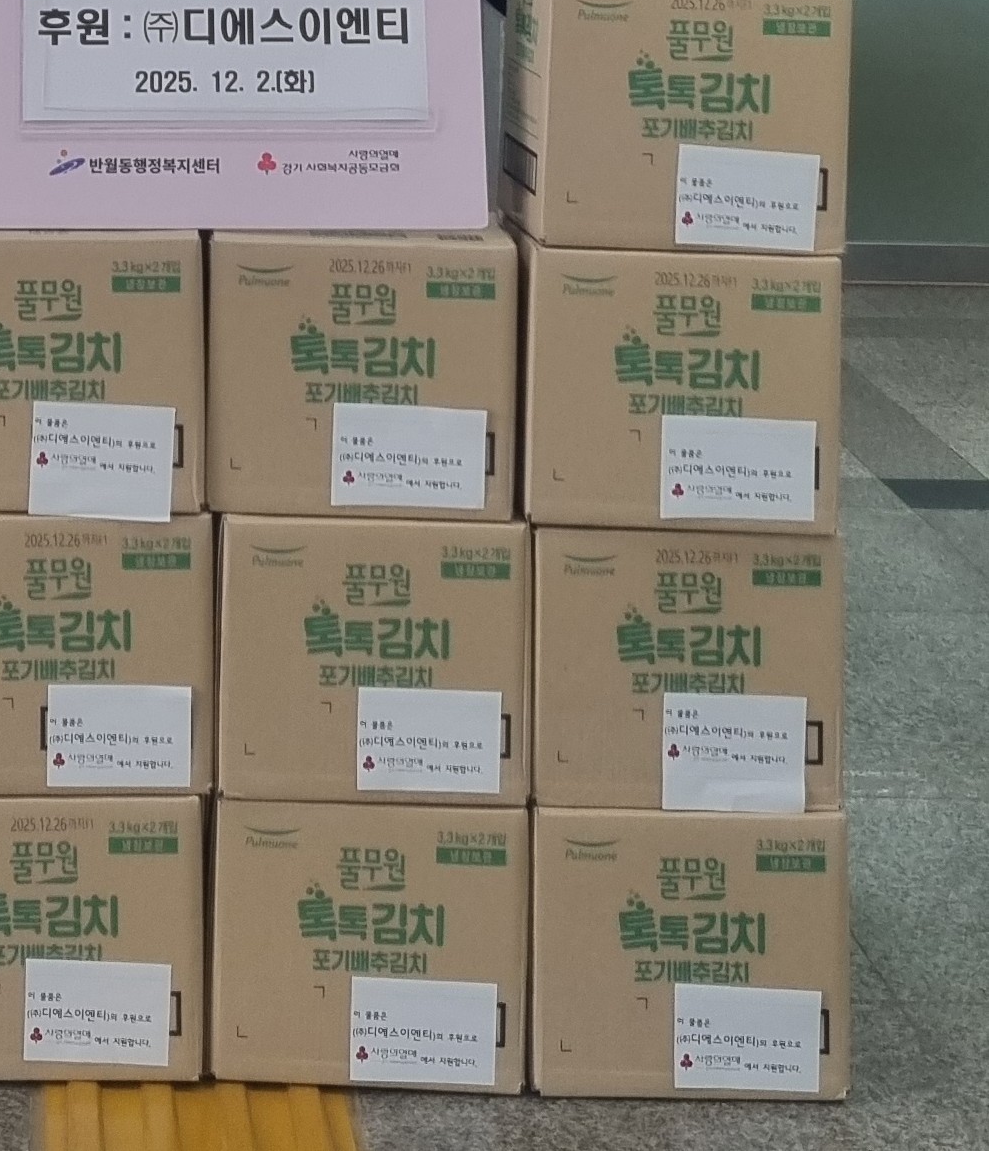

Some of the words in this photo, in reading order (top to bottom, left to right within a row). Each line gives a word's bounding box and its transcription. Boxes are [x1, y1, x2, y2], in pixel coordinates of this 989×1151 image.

[38, 8, 110, 46] 후원
[666, 19, 734, 62] 풀무원
[135, 70, 198, 93] 2025.
[213, 70, 244, 93] 12.
[256, 69, 315, 94] 2.(화)
[628, 68, 770, 114] 톡톡김치
[642, 117, 753, 141] 포기배추김치
[89, 157, 221, 175] 반월동행정복지센터
[282, 163, 302, 175] 경기
[14, 279, 82, 321] 풀무원
[328, 283, 396, 325] 풀무원
[653, 295, 721, 337] 풀무원
[290, 331, 436, 378] 톡톡김치
[614, 343, 760, 390] 톡톡김치
[305, 381, 418, 405] 포기배추김치
[628, 393, 742, 417] 포기배추김치
[23, 557, 92, 600] 풀무원
[342, 563, 411, 606] 풀무원
[654, 572, 721, 614] 풀무원
[304, 613, 450, 660] 톡톡김치
[616, 620, 761, 667] 톡톡김치
[1, 658, 115, 681] 포기배추김치
[319, 665, 432, 687] 포기배추김치
[632, 672, 745, 695] 포기배추김치
[10, 841, 78, 884] 풀무원
[337, 847, 405, 891] 풀무원
[656, 857, 726, 900] 풀무원
[297, 897, 444, 947] 톡톡김치
[619, 907, 765, 955] 톡톡김치
[313, 949, 427, 974] 포기배추김치
[634, 959, 749, 983] 포기배추김치
